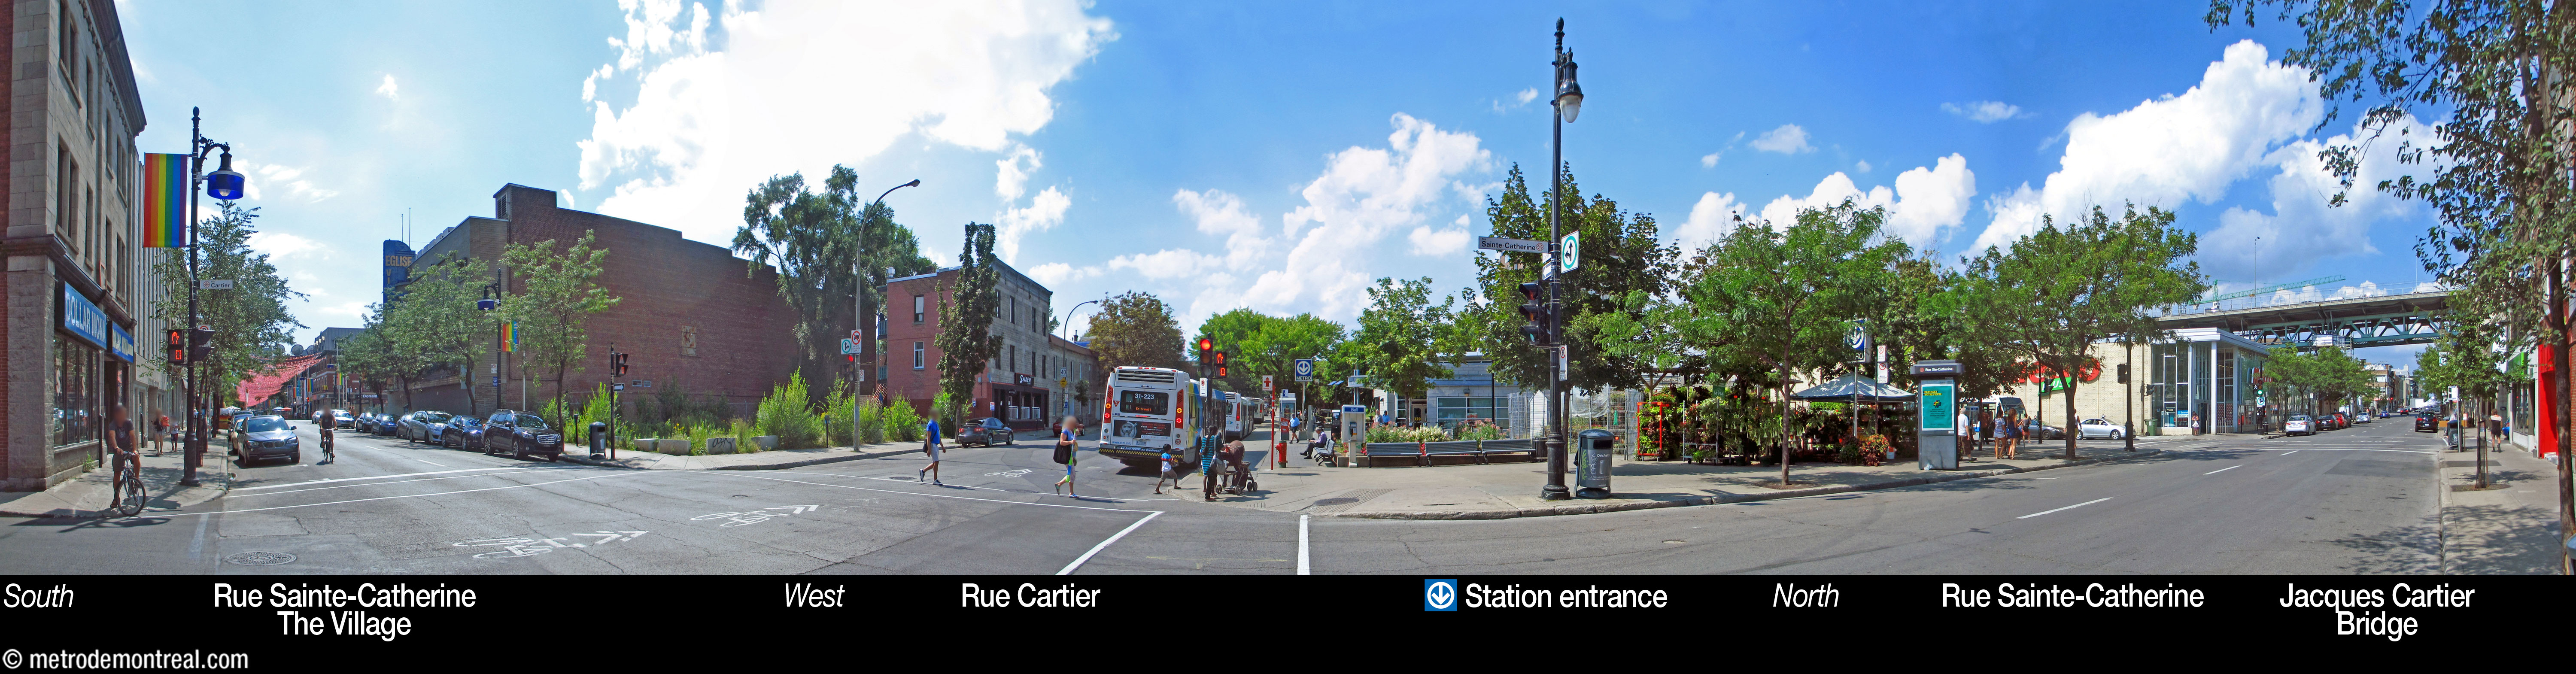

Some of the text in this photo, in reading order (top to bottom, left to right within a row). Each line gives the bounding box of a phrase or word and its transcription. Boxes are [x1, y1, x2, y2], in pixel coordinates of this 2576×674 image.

[1482, 241, 1536, 250] Sainte-Catherine
[65, 291, 106, 343] DOLLAR MONA
[175, 350, 182, 360] 0
[1220, 367, 1226, 376] 0
